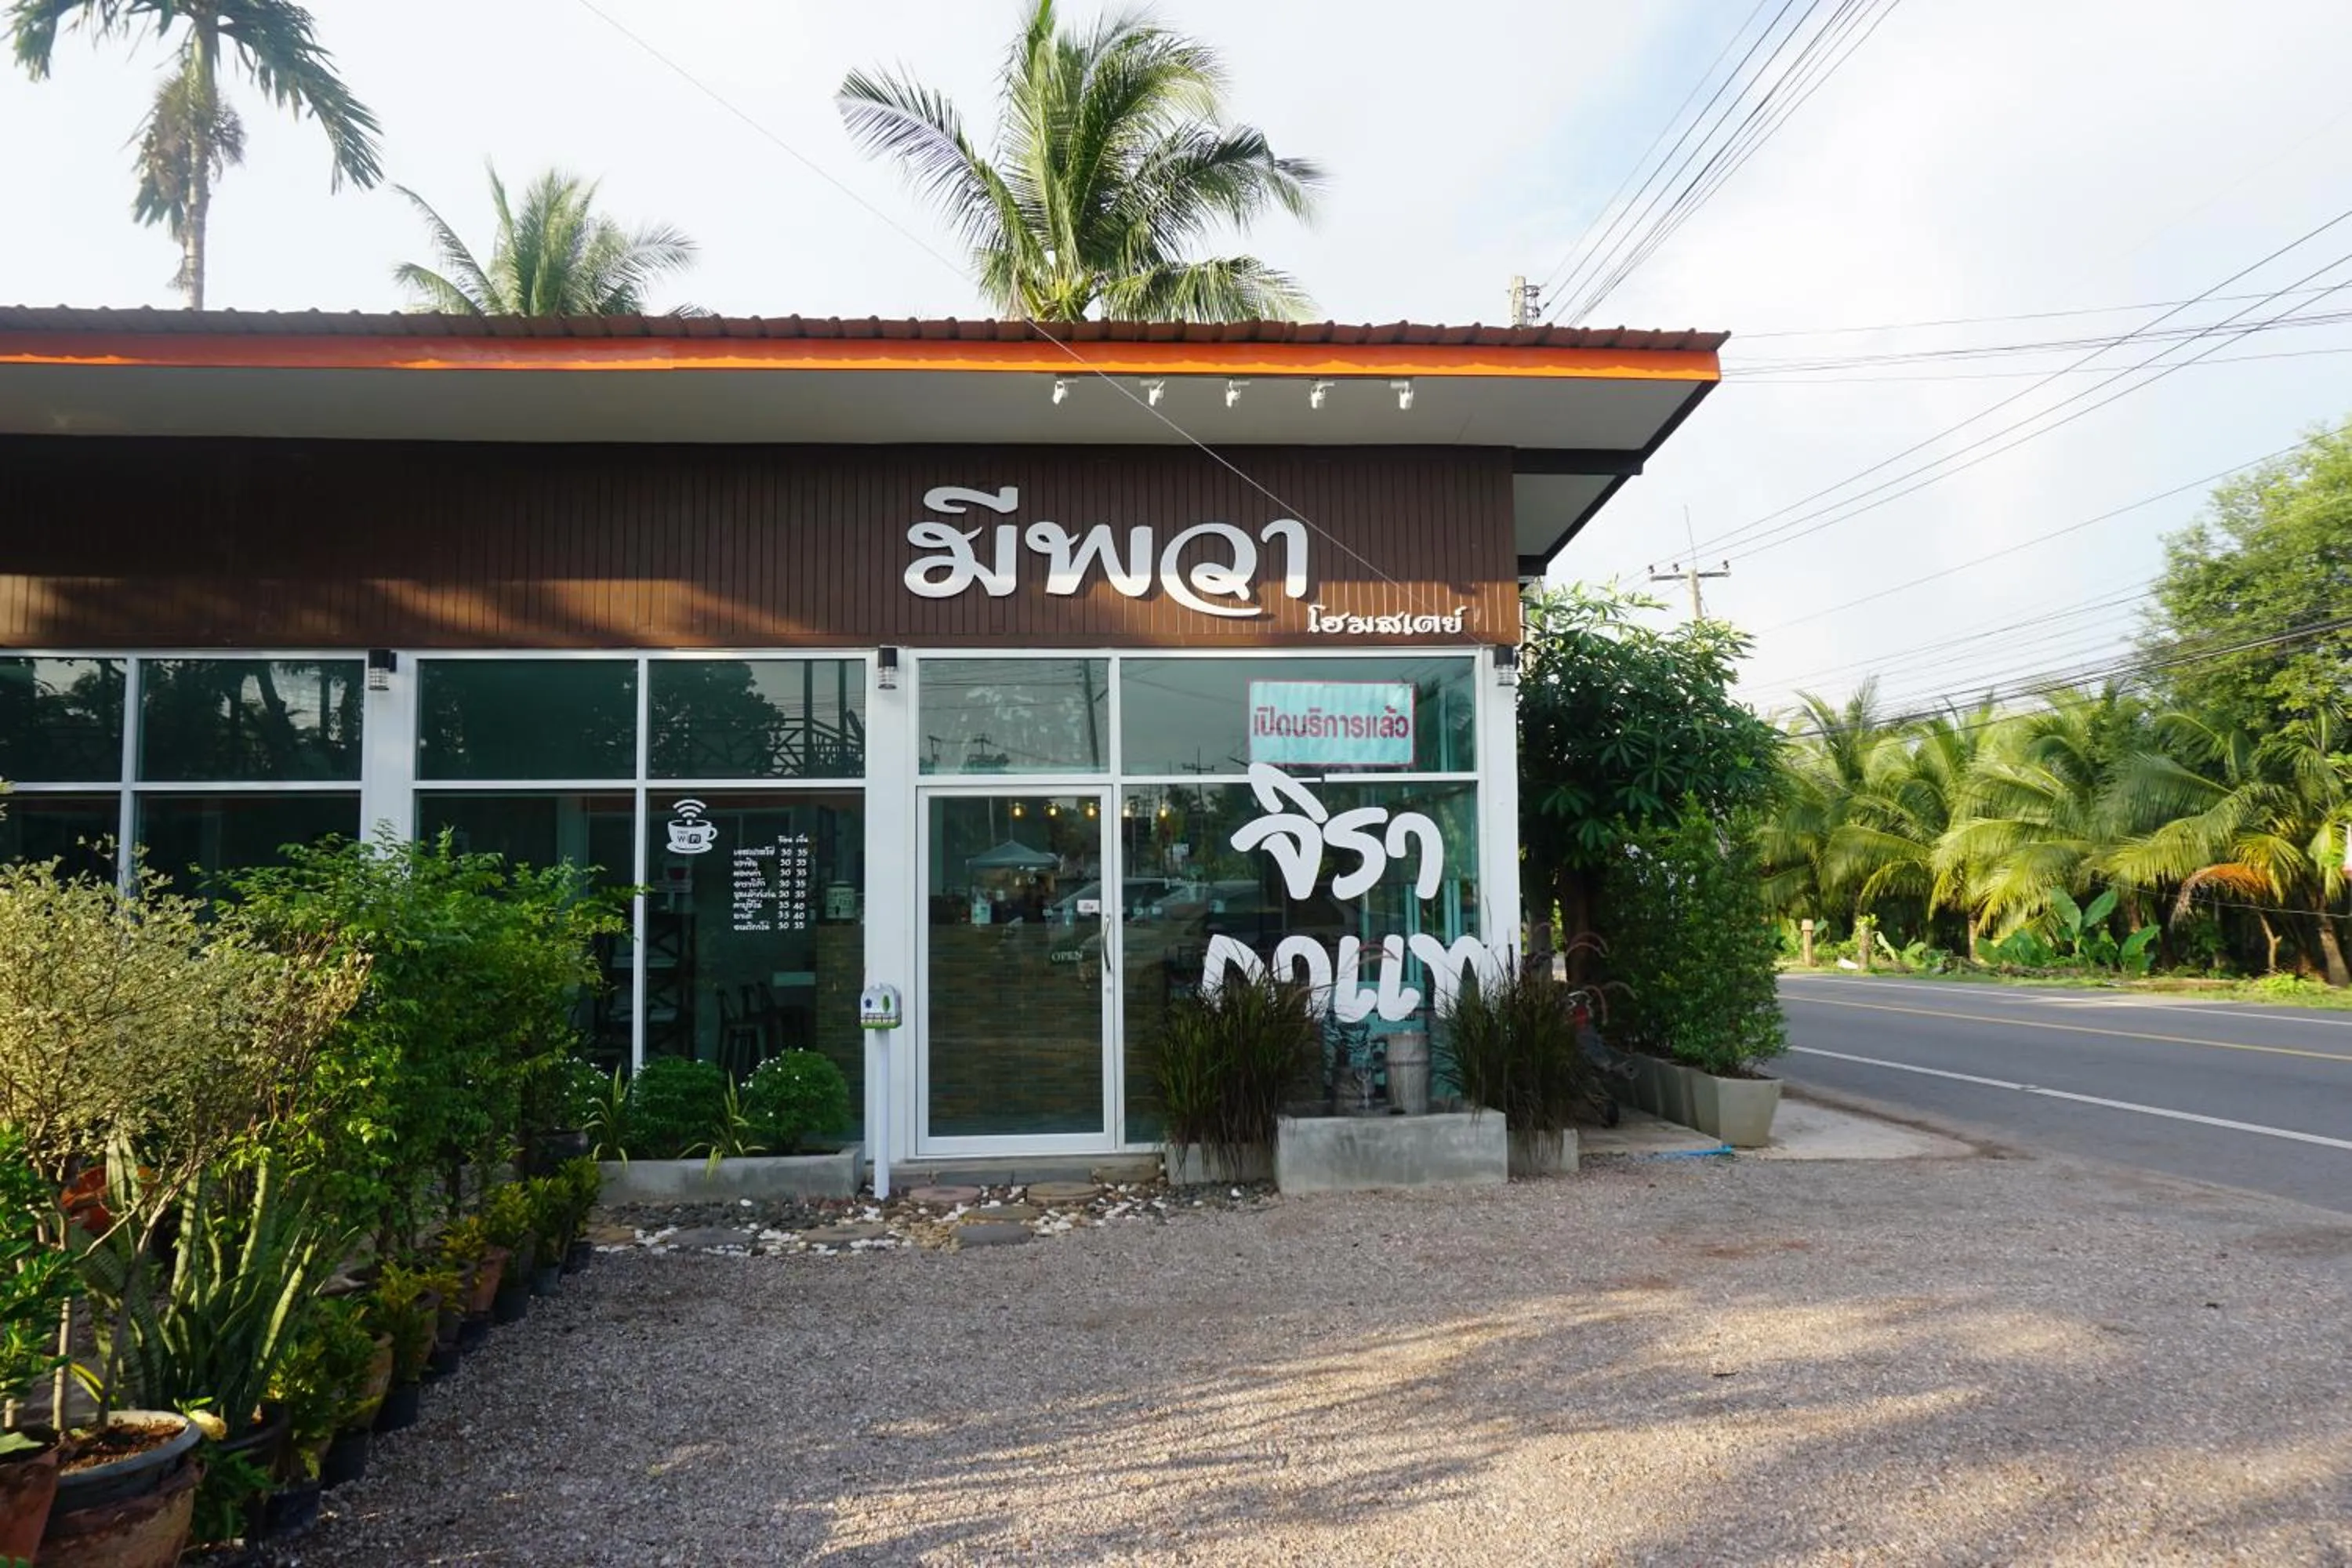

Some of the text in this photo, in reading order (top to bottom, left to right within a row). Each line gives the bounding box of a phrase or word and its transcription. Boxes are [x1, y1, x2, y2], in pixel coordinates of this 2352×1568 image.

[1307, 604, 1468, 635] โฮมสเตย์
[1253, 705, 1410, 739] เปิดบริการแล้ว
[1230, 761, 1445, 901] จิรา
[1051, 950, 1083, 963] OPEN
